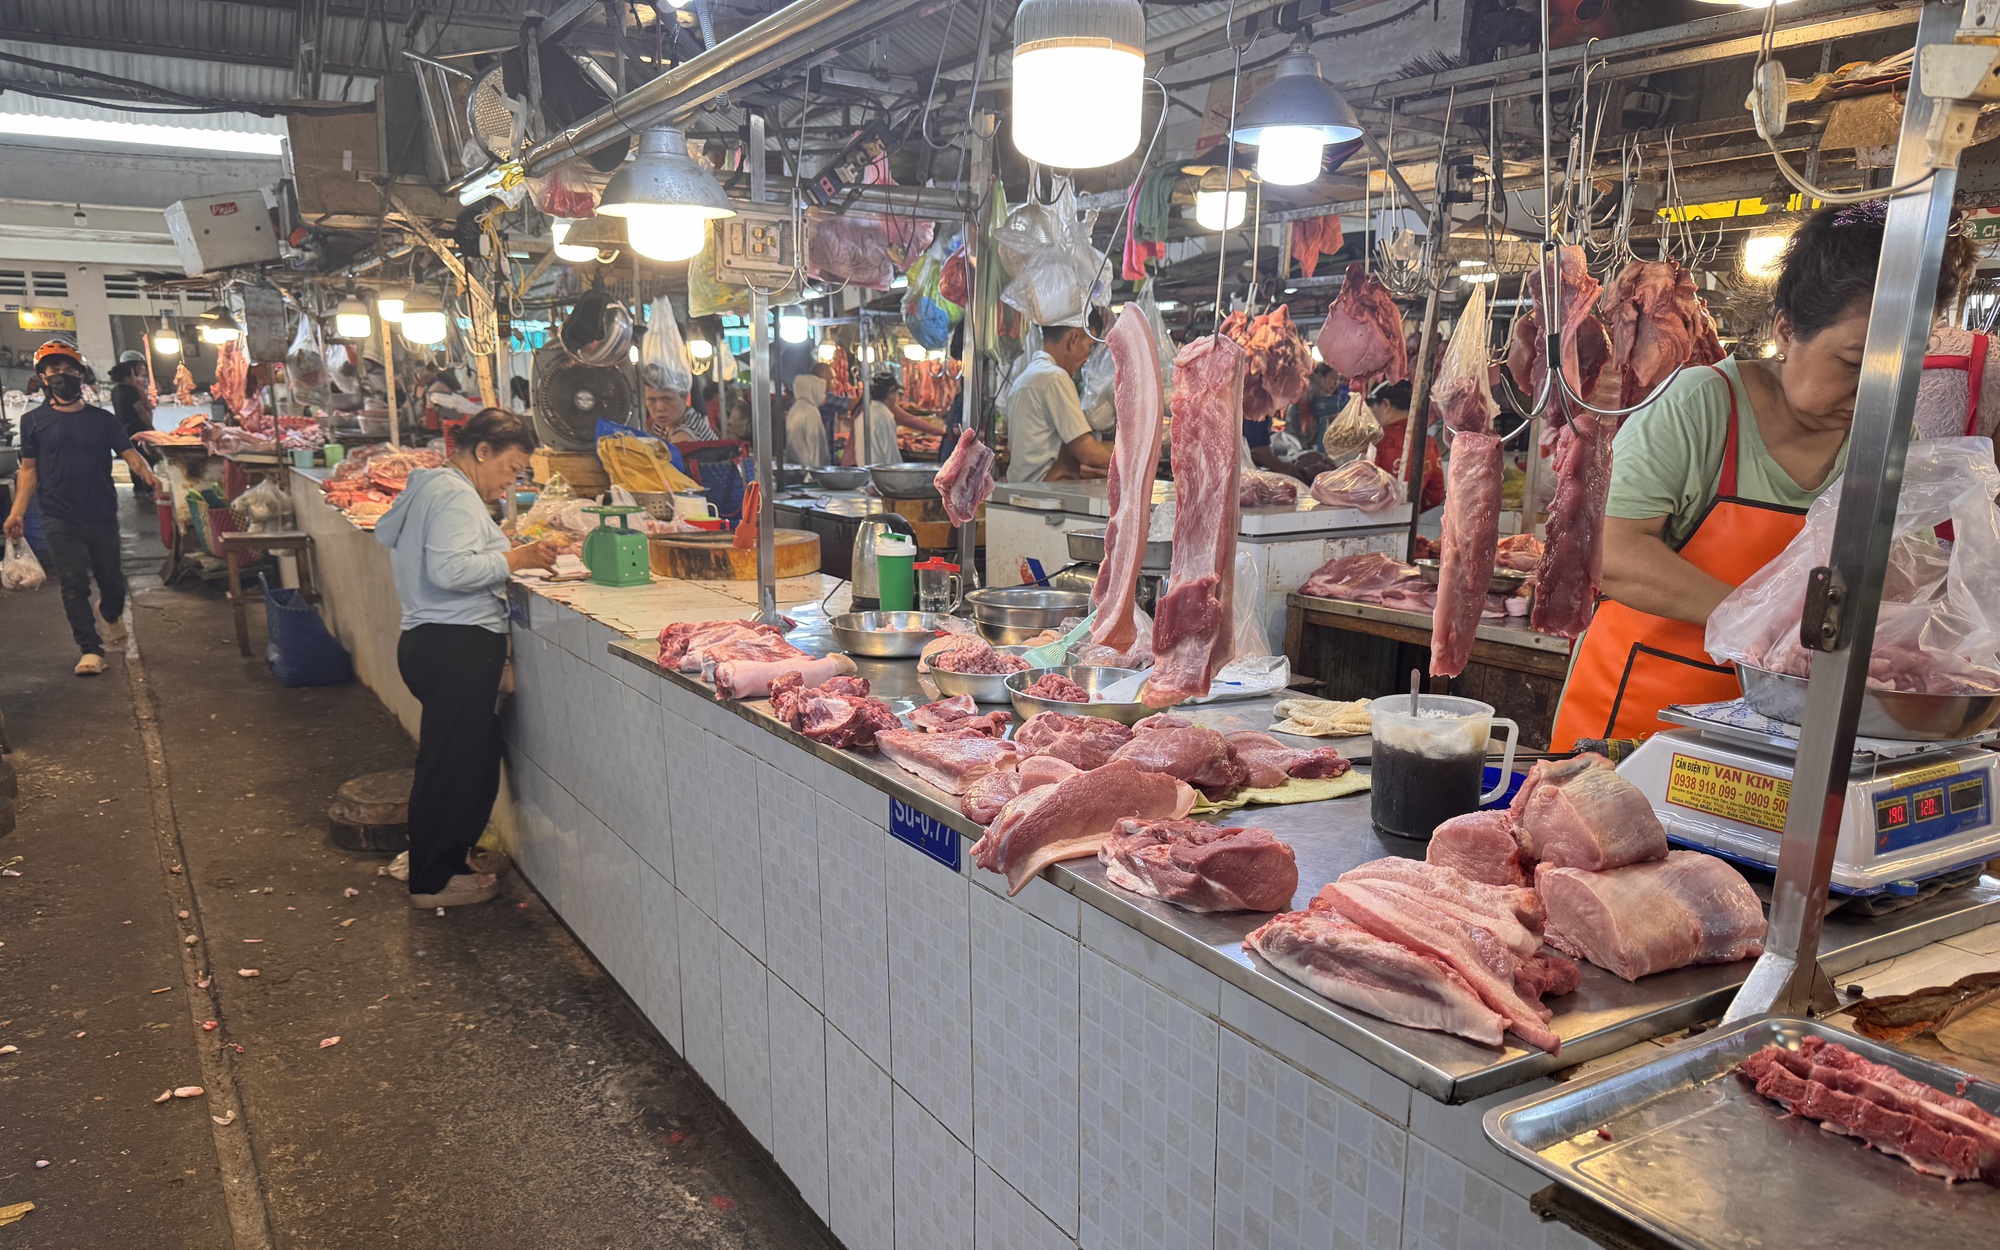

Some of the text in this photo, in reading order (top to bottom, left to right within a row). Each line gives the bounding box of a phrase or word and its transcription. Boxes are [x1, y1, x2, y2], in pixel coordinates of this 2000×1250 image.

[1674, 773, 1697, 790] 0938
[1698, 779, 1716, 795] 918
[1718, 784, 1736, 800] 099
[1744, 791, 1770, 809] 0909
[1675, 757, 1687, 770] CÂN
[1687, 761, 1701, 775] ĐIỆN
[1714, 766, 1742, 784] VẠN
[1745, 774, 1774, 791] KIM
[1889, 805, 1903, 824] 190
